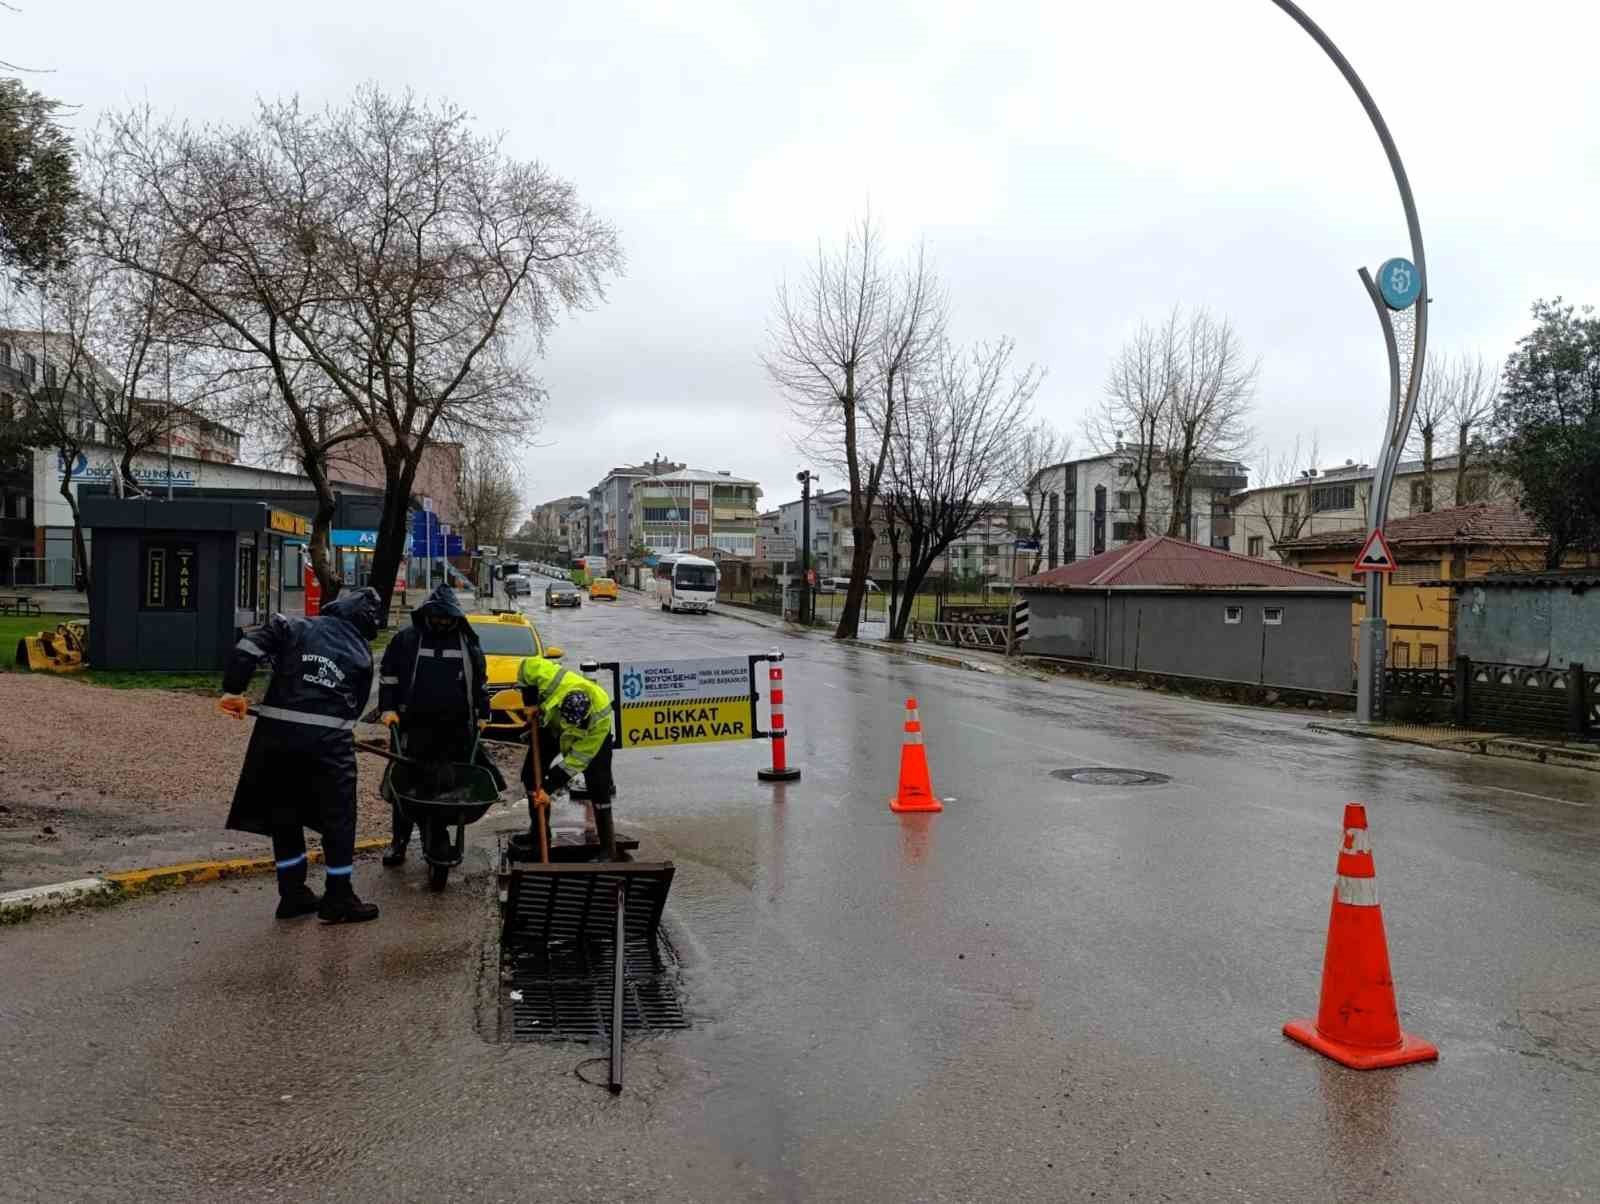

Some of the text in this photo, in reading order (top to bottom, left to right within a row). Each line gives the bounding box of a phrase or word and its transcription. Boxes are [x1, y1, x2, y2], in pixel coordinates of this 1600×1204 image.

[654, 707, 719, 724] DİKKAT
[629, 721, 743, 745] ÇALIŞMA VAR
